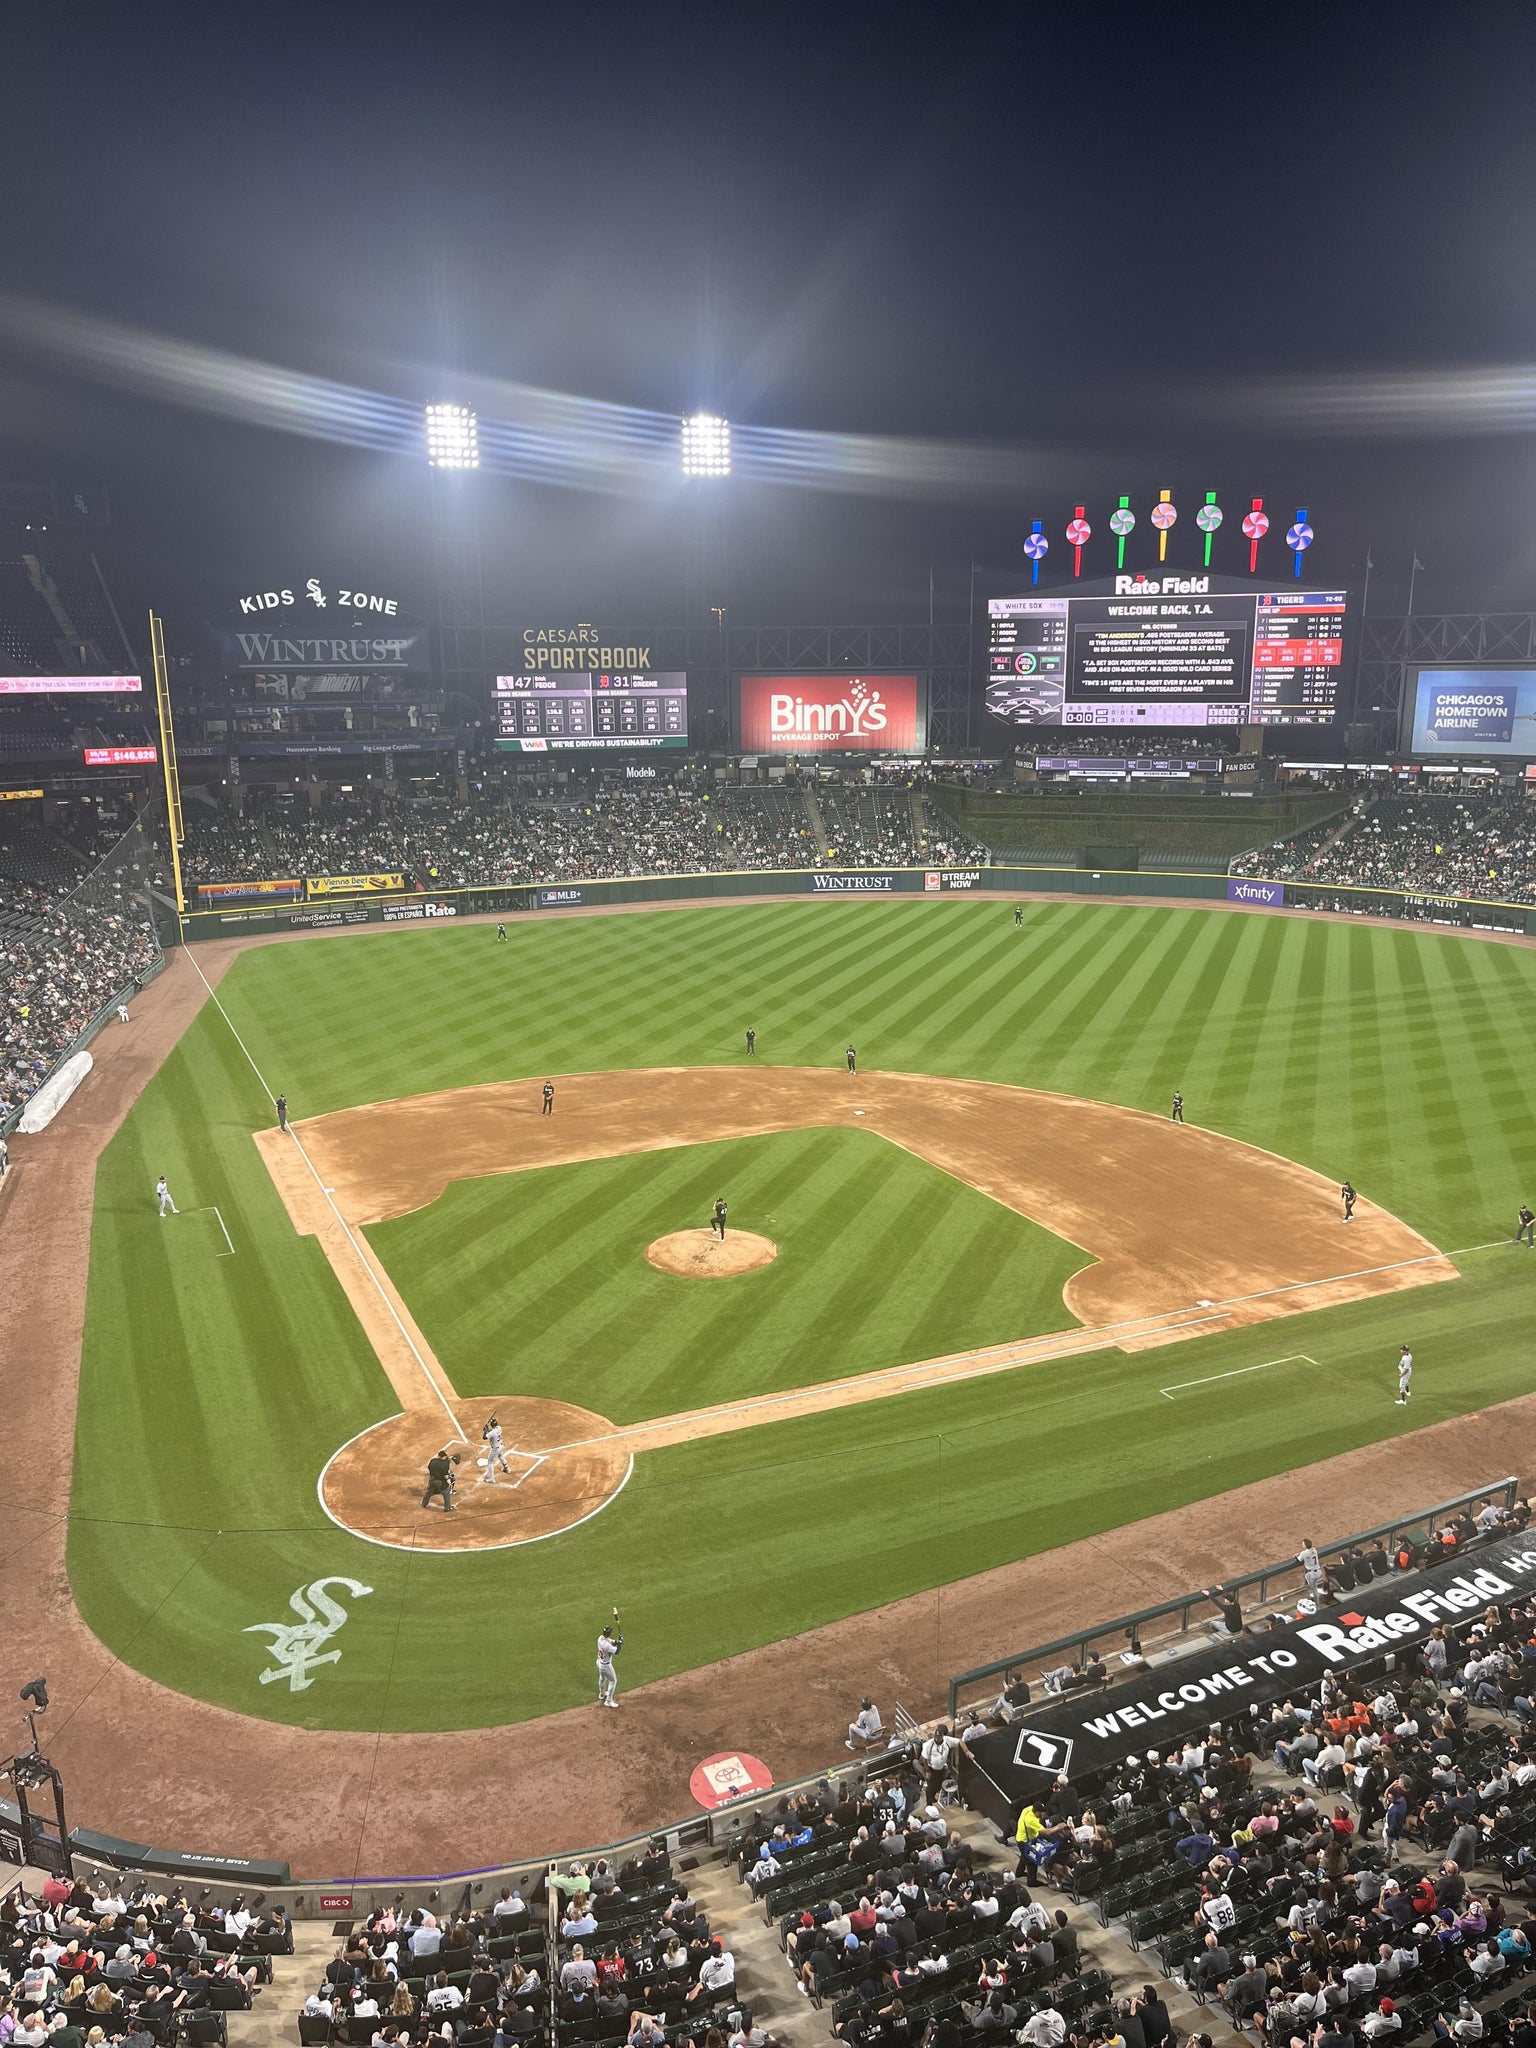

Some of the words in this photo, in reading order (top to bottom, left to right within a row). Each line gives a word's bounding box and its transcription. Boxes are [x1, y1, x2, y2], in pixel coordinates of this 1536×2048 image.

[1115, 575, 1160, 595] Rate
[1162, 576, 1209, 594] Field
[239, 589, 295, 614] KIDS
[338, 590, 398, 616] ZONE
[1276, 596, 1304, 604] TIGERS
[1108, 605, 1158, 616] WELCOME
[1160, 604, 1192, 615] BACK,
[1194, 604, 1214, 614] T.A.
[523, 629, 599, 643] CAESARS
[235, 633, 409, 663] WINTRUST
[524, 647, 651, 669] SPORTSBOOK
[514, 676, 532, 688] 47
[534, 681, 557, 689] FEDDE
[613, 676, 630, 687] 31
[633, 680, 658, 688] GREENE
[1436, 694, 1504, 705] CHICAGO'S
[770, 690, 888, 737] Binny's
[1435, 706, 1508, 717] HOMETOWN
[1085, 713, 1092, 722] 0
[1434, 718, 1479, 728] AIRLINE
[771, 733, 812, 741] BEVERAGE
[813, 733, 840, 741] DEPOT
[318, 746, 342, 754] Banking
[363, 744, 391, 752] Big-League
[392, 743, 421, 751] Capabilities
[551, 740, 575, 749] WE'RE
[575, 739, 605, 748] DRIVING
[1023, 761, 1034, 769] DECK
[626, 766, 656, 778] Modelo
[812, 874, 893, 889] WINTRUST
[942, 872, 980, 881] STREAM
[950, 880, 972, 889] NOW
[223, 885, 258, 897] Surfside
[557, 890, 582, 900] MLB+
[1234, 884, 1276, 902] xfinity
[383, 913, 397, 921] 100%
[404, 910, 425, 919] ESPAÑOL
[425, 903, 457, 917] Rate
[291, 912, 342, 924] UnitedService
[312, 919, 344, 928] Companies
[1296, 1610, 1421, 1663] Rate
[1399, 1567, 1515, 1624] Field
[1082, 1665, 1255, 1739] WELCOME
[1247, 1649, 1298, 1674] TO
[879, 1809, 894, 1821] 33
[1217, 1907, 1234, 1924] 88
[1030, 1917, 1039, 1926] 5
[604, 1964, 618, 1973] SOSA
[635, 1957, 654, 1974] 73
[433, 1993, 450, 2001] THOME
